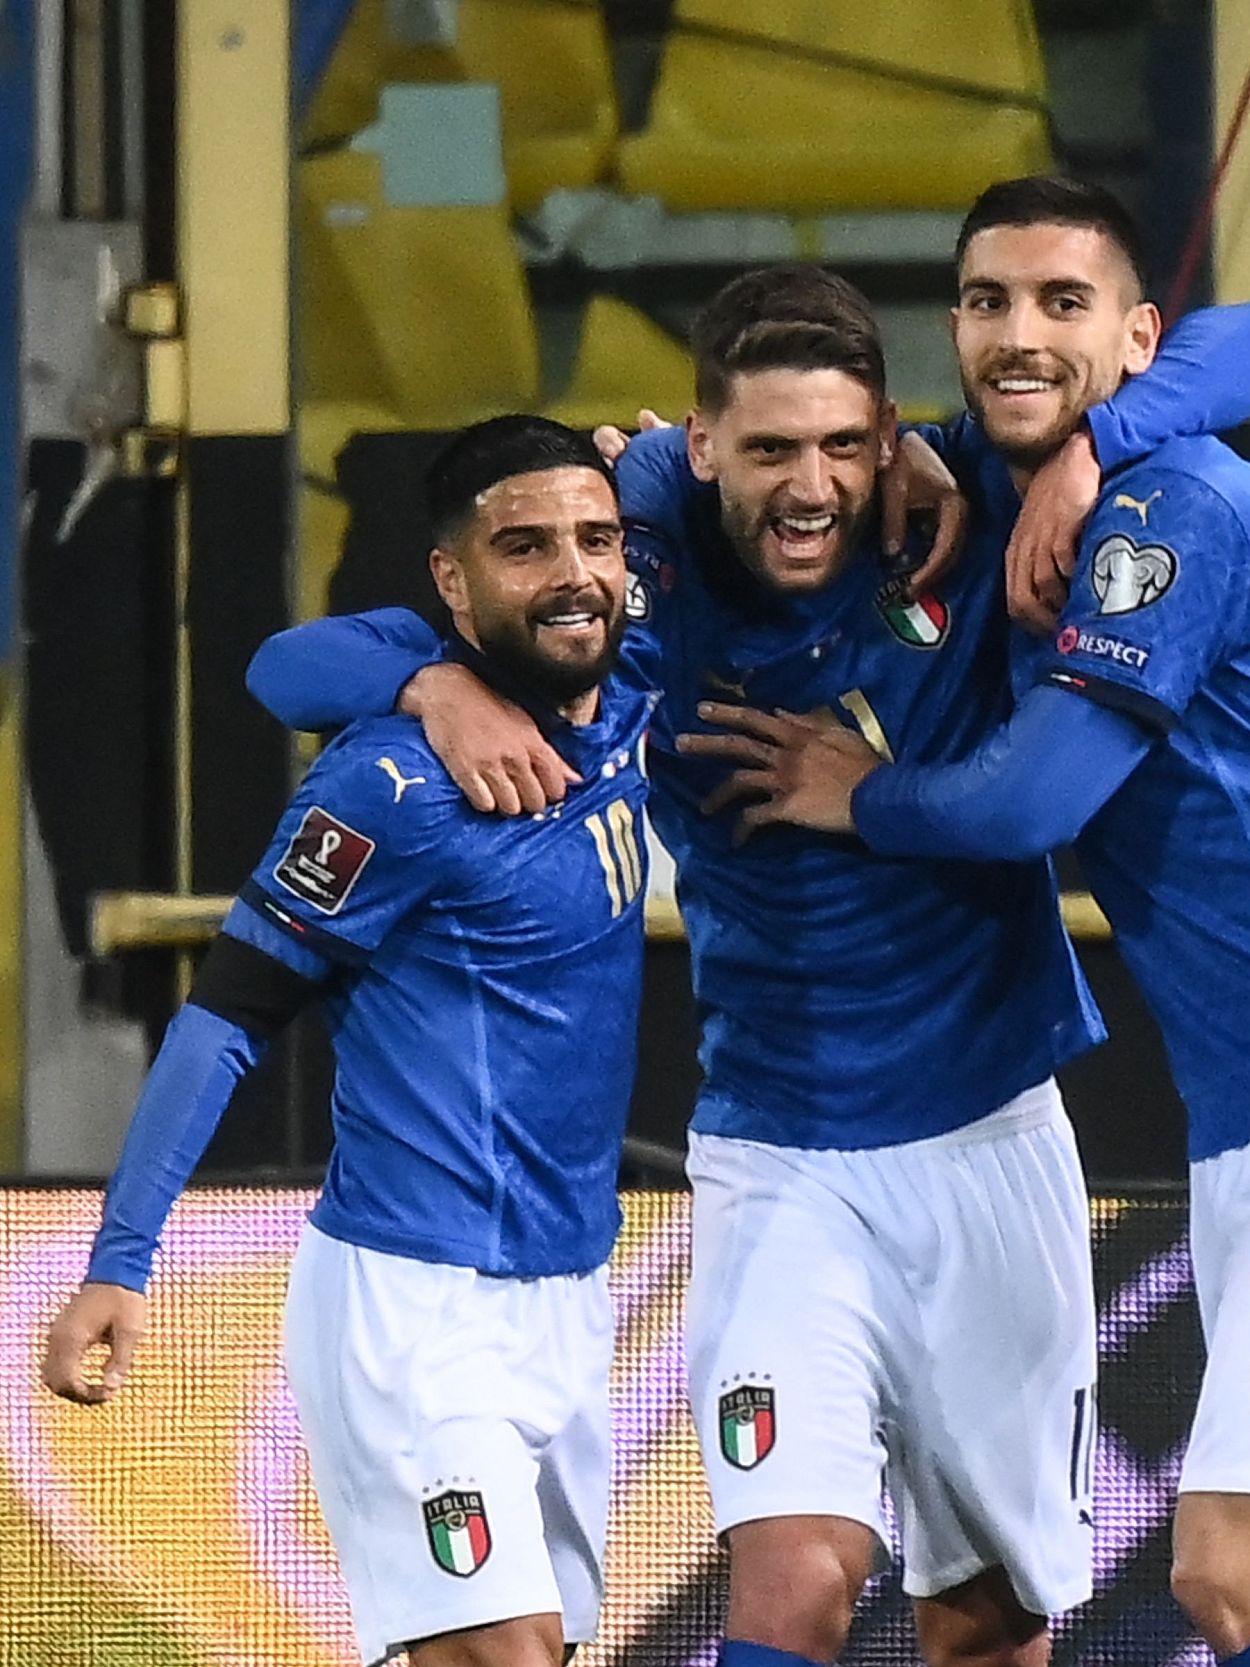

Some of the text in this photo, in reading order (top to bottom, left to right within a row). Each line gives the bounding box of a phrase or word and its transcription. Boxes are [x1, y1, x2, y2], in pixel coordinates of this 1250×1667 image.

[1077, 634, 1149, 667] RESPECT
[722, 1390, 770, 1410] ITALIA
[427, 1495, 480, 1517] ITALIA
